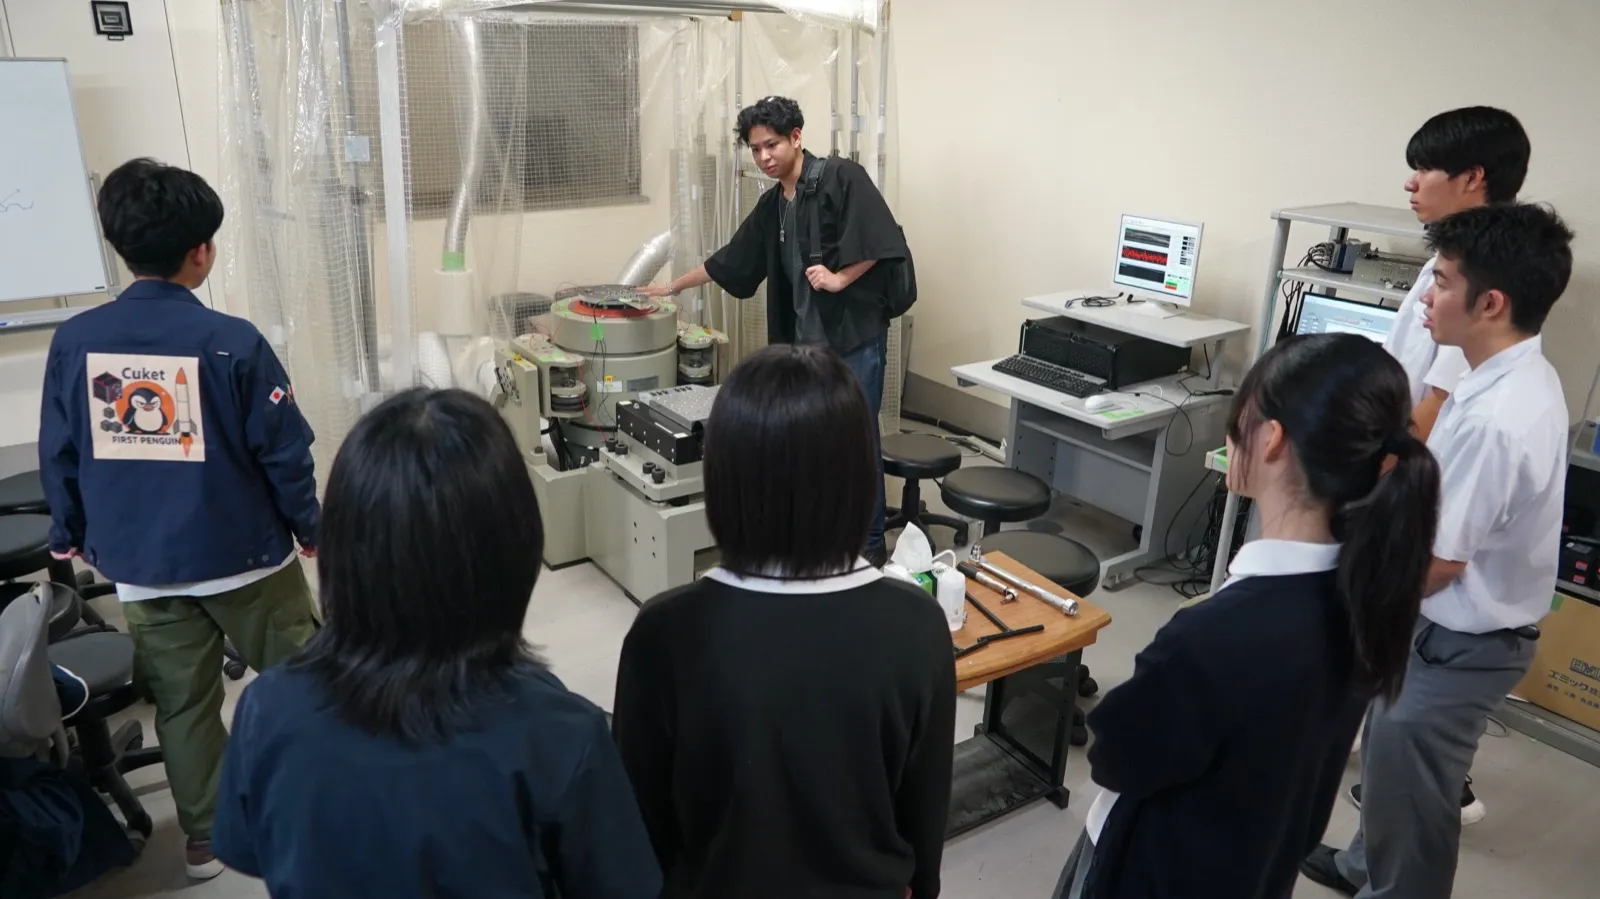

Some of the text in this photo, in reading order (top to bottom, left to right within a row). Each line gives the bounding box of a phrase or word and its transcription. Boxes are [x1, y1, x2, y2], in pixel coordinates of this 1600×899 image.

[121, 367, 166, 381] Cuket
[112, 436, 181, 445] FIRST PENGUIN
